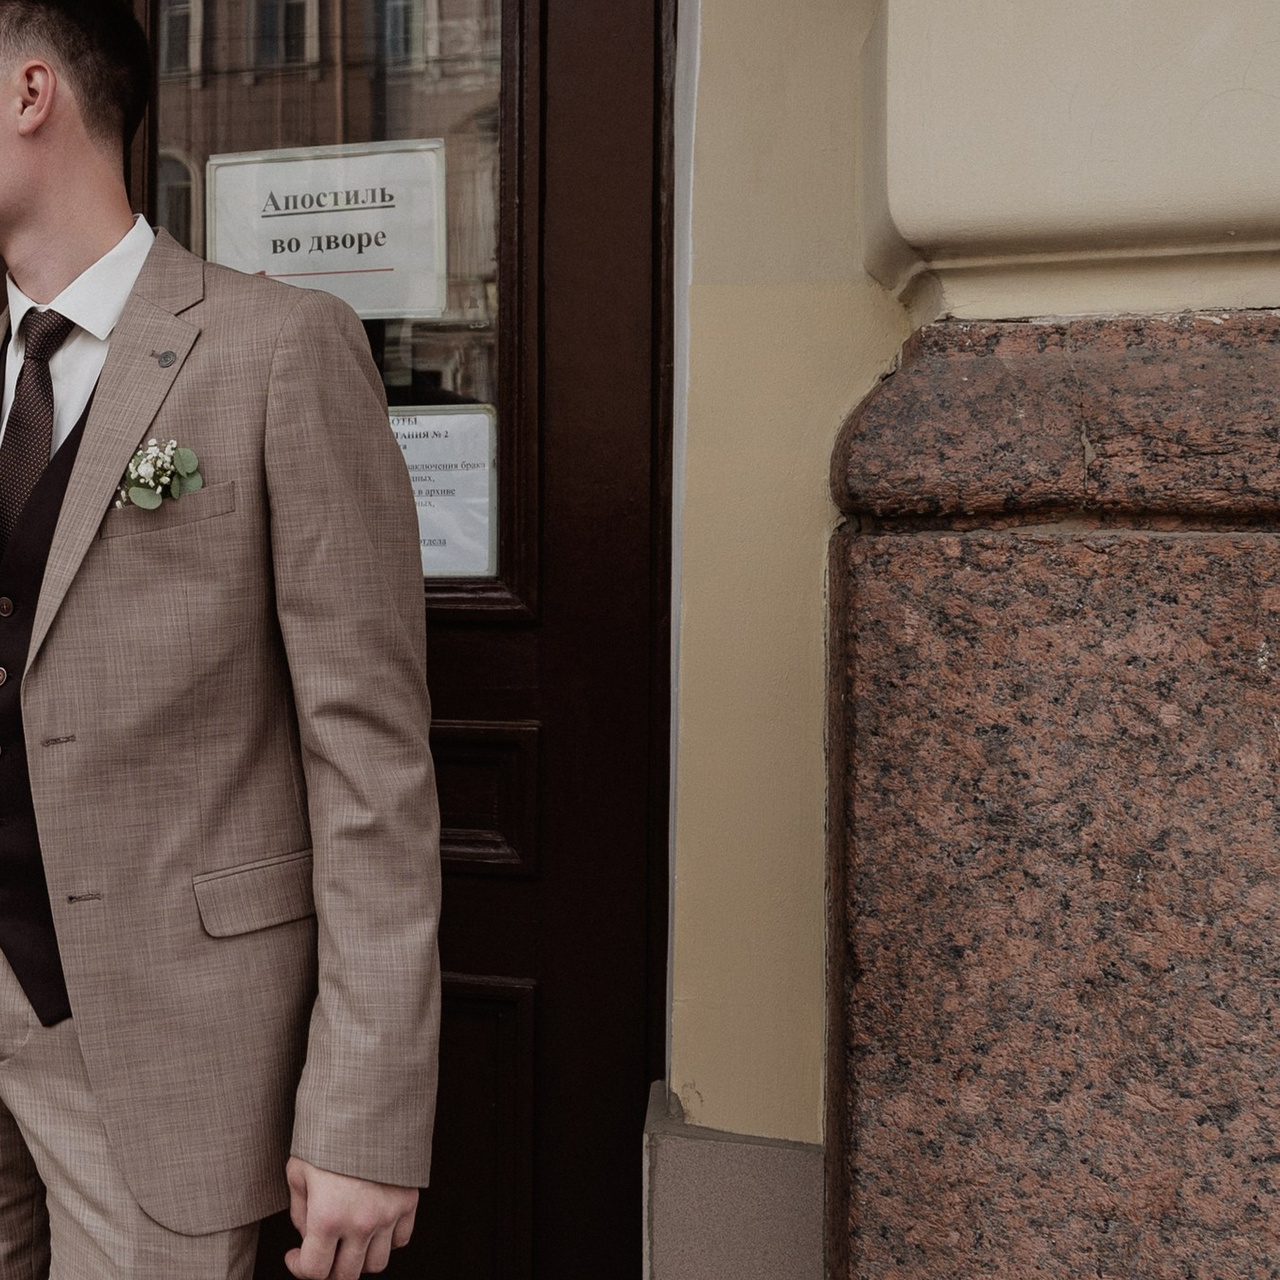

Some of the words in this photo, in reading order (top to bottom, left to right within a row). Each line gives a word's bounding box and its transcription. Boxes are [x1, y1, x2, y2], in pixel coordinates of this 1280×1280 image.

[262, 186, 395, 213] Апостиль
[272, 237, 301, 254] во
[308, 230, 387, 255] дворе
[461, 460, 486, 471] брака
[425, 488, 456, 497] архиве
